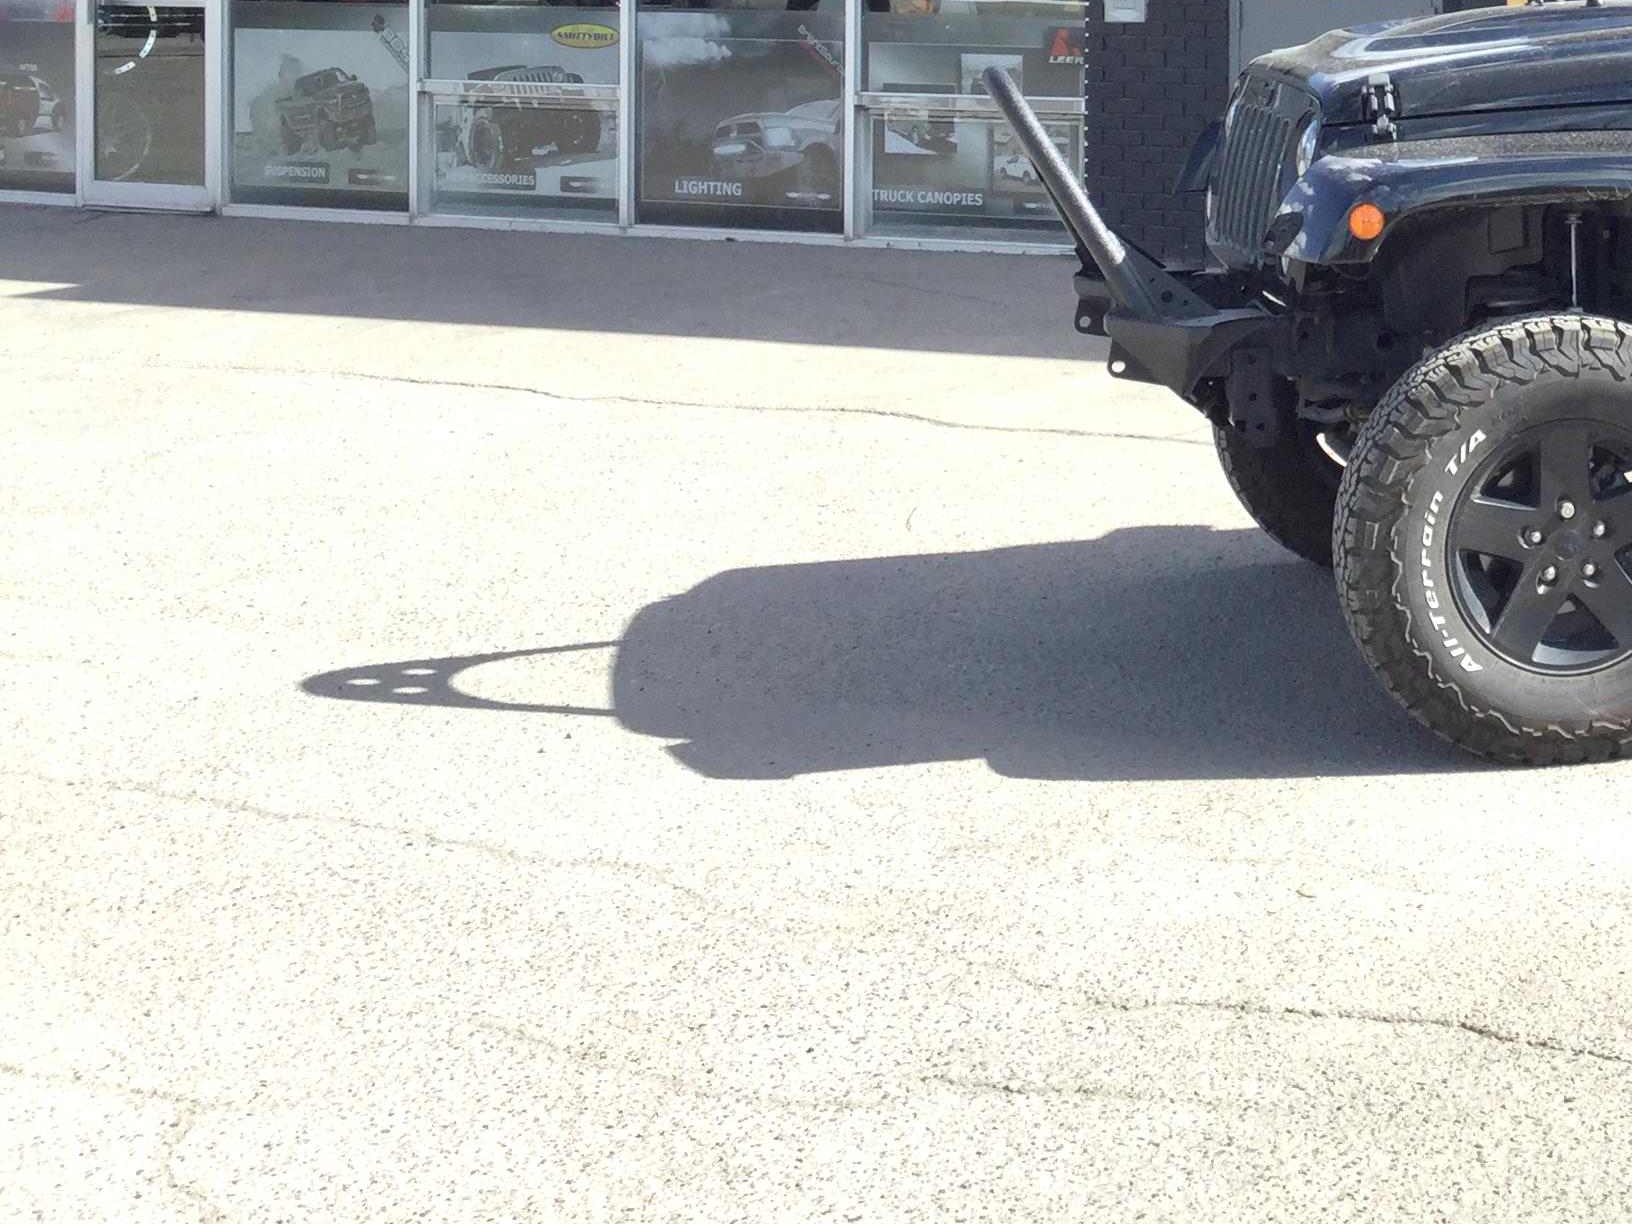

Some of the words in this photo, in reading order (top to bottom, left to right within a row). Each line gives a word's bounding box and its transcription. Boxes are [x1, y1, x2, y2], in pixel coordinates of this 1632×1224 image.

[1049, 55, 1084, 64] LEER
[264, 164, 327, 178] SUSPENSION
[674, 179, 742, 196] LIGHTING
[872, 188, 914, 203] TRUCK
[916, 190, 983, 206] CANOPIES
[1444, 429, 1487, 476] T/A
[1421, 490, 1484, 672] All-Terrain
